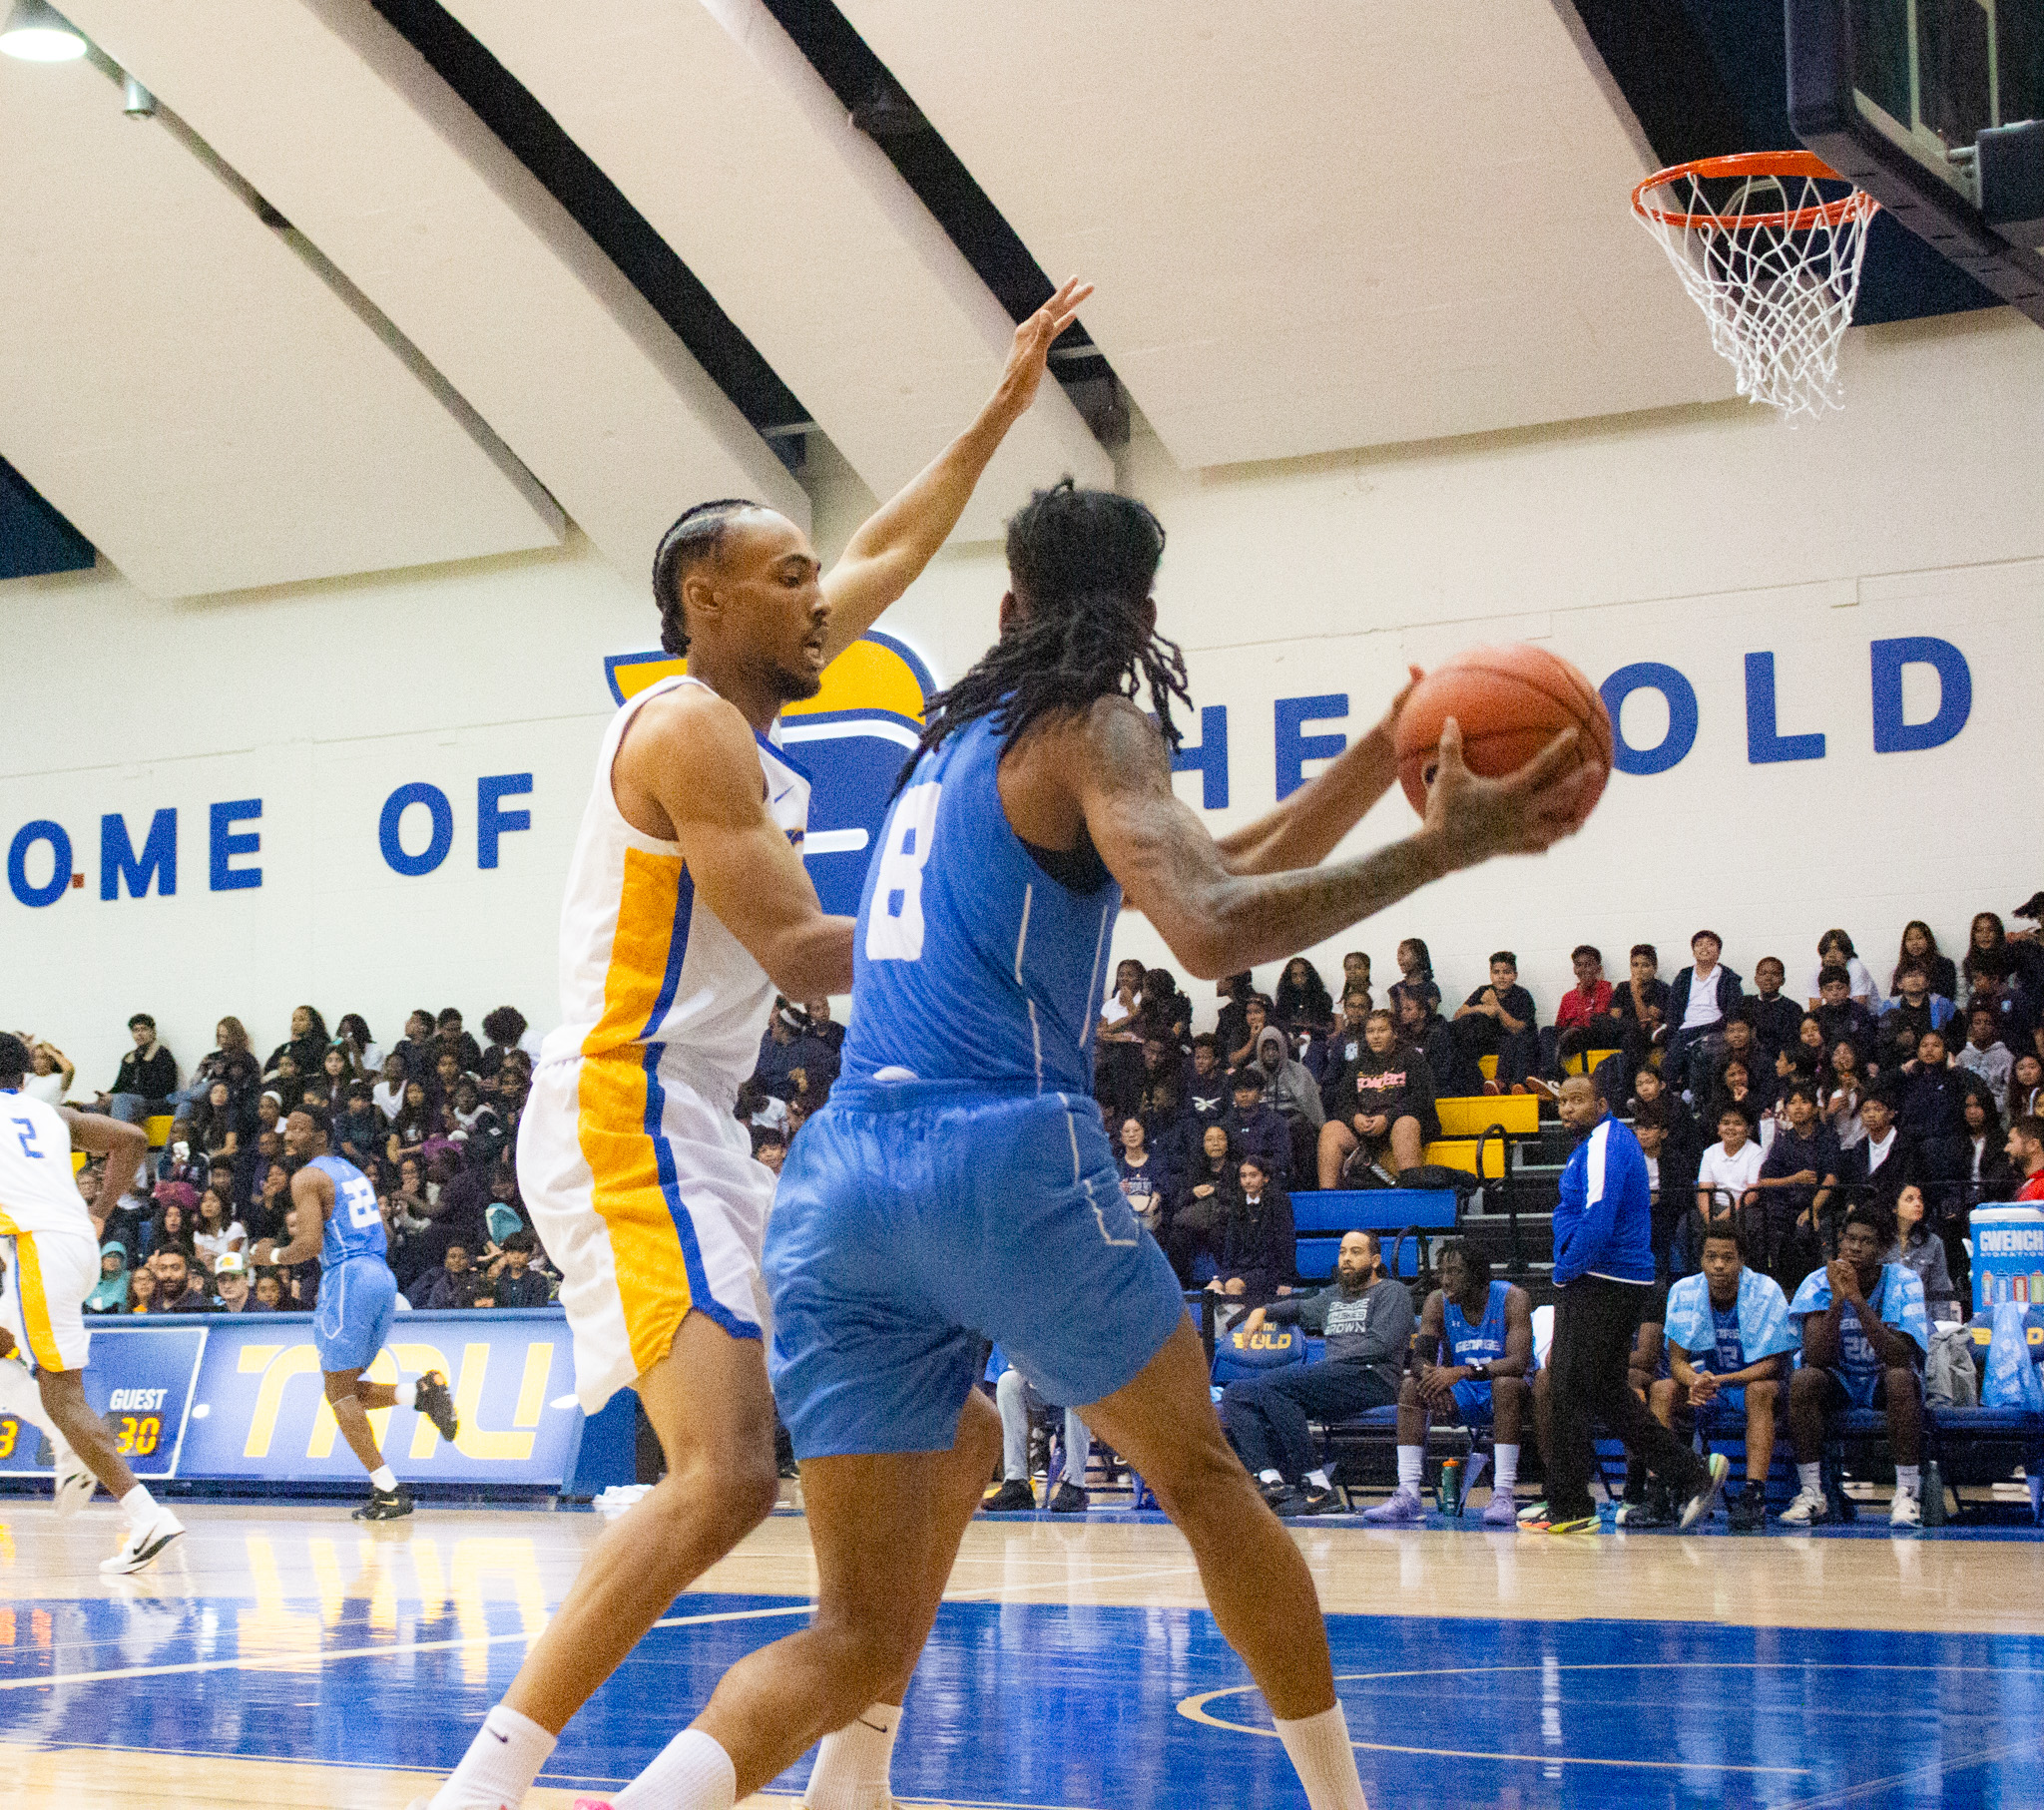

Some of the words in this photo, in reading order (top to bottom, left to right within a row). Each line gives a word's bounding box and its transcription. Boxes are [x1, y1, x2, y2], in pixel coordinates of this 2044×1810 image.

[379, 772, 533, 876] OF
[865, 781, 942, 961] 8
[10, 1118, 45, 1158] 2
[340, 1176, 382, 1229] 22
[1455, 1338, 1501, 1353] GEORGE
[110, 1388, 168, 1411] GUEST
[237, 1342, 554, 1460] TMU
[116, 1417, 161, 1455] 30
